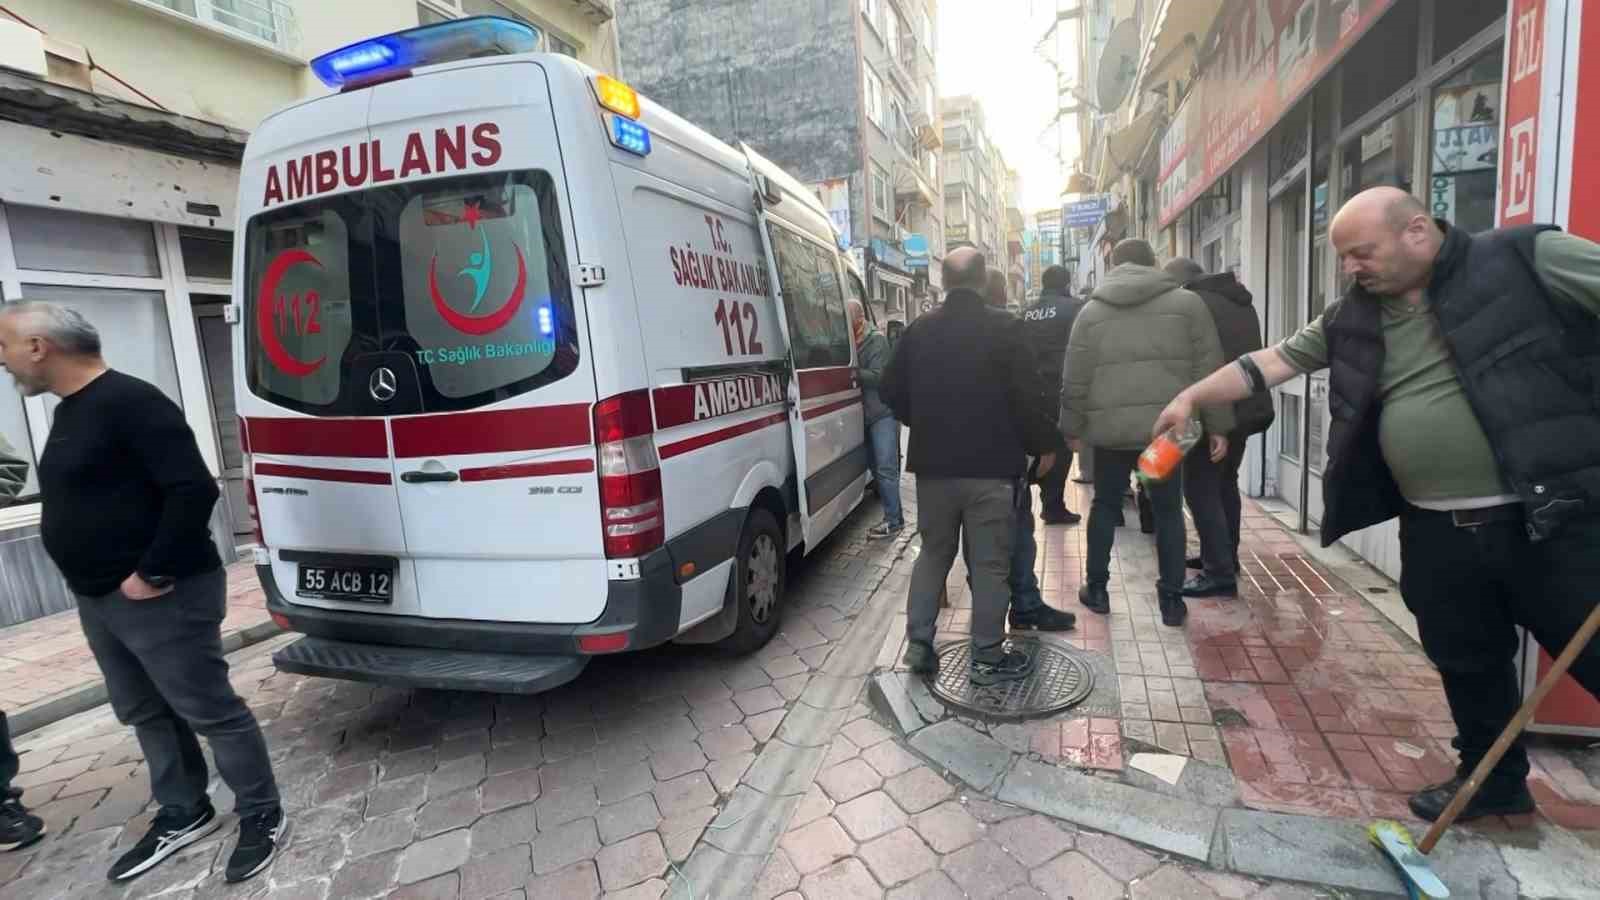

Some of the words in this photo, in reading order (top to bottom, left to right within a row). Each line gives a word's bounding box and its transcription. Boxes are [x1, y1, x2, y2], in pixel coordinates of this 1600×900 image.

[264, 122, 502, 206] AMBULANS
[670, 241, 719, 290] SAĞLIK
[275, 291, 320, 337] 112
[715, 298, 764, 356] 112
[438, 345, 481, 365] Sağlık
[693, 374, 783, 421] AMBULAN
[305, 568, 326, 590] 55
[330, 571, 362, 593] ACB
[368, 573, 389, 595] 12
